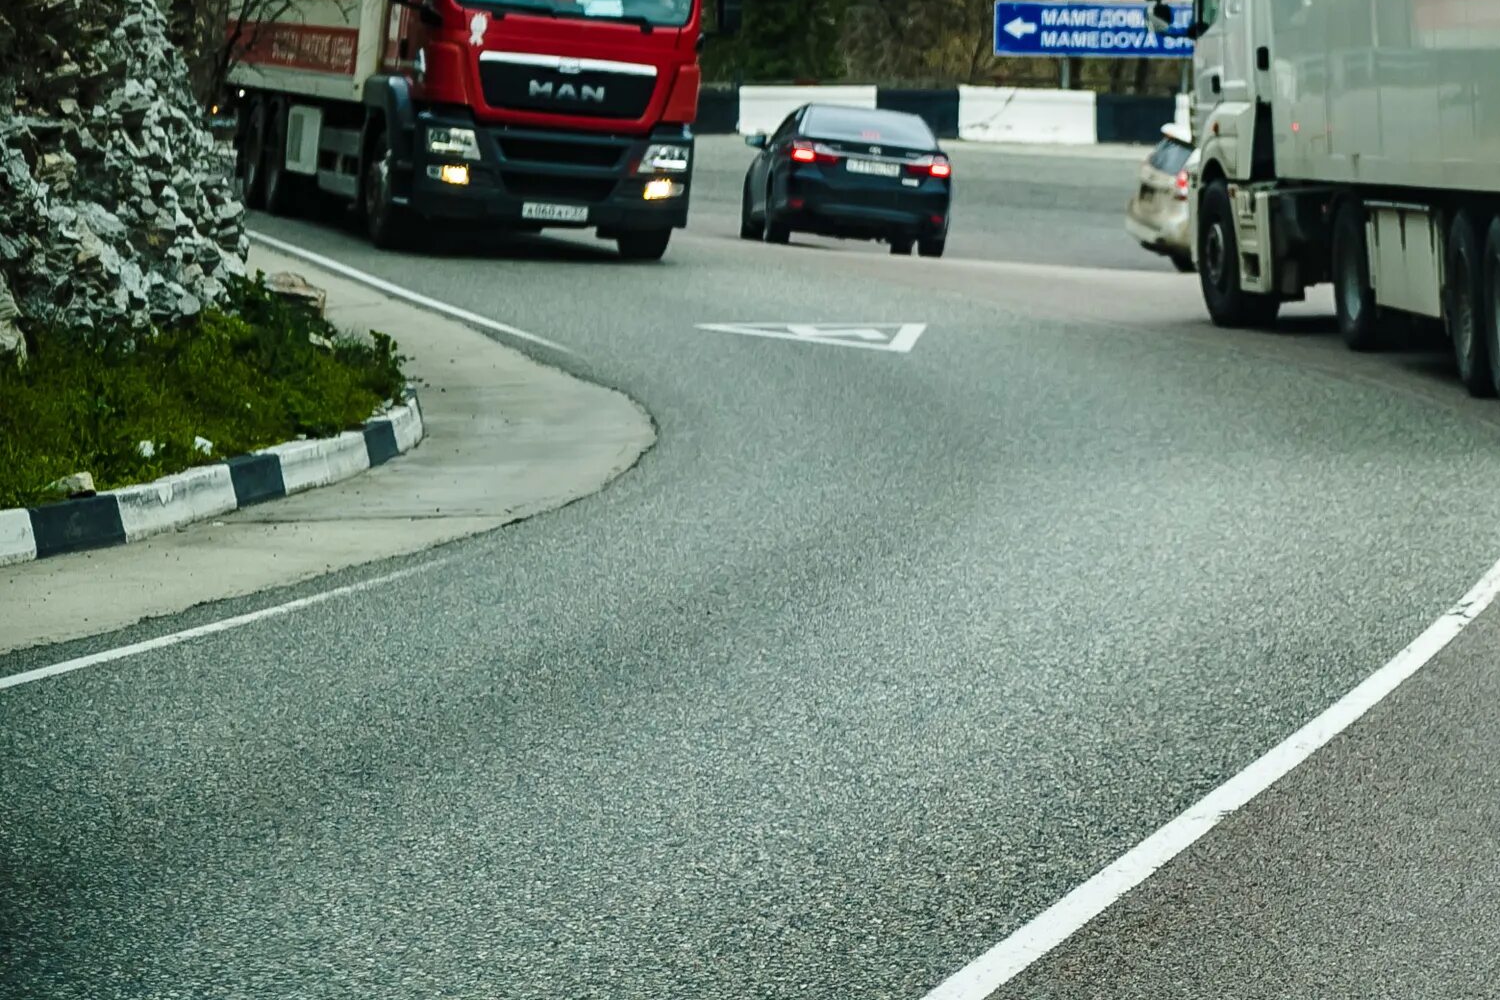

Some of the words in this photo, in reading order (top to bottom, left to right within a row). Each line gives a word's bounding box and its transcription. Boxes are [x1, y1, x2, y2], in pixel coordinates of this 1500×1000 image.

[1041, 8, 1144, 28] МАМЕДОВ
[1040, 31, 1159, 48] MAMEDOVA
[529, 79, 605, 102] MAN
